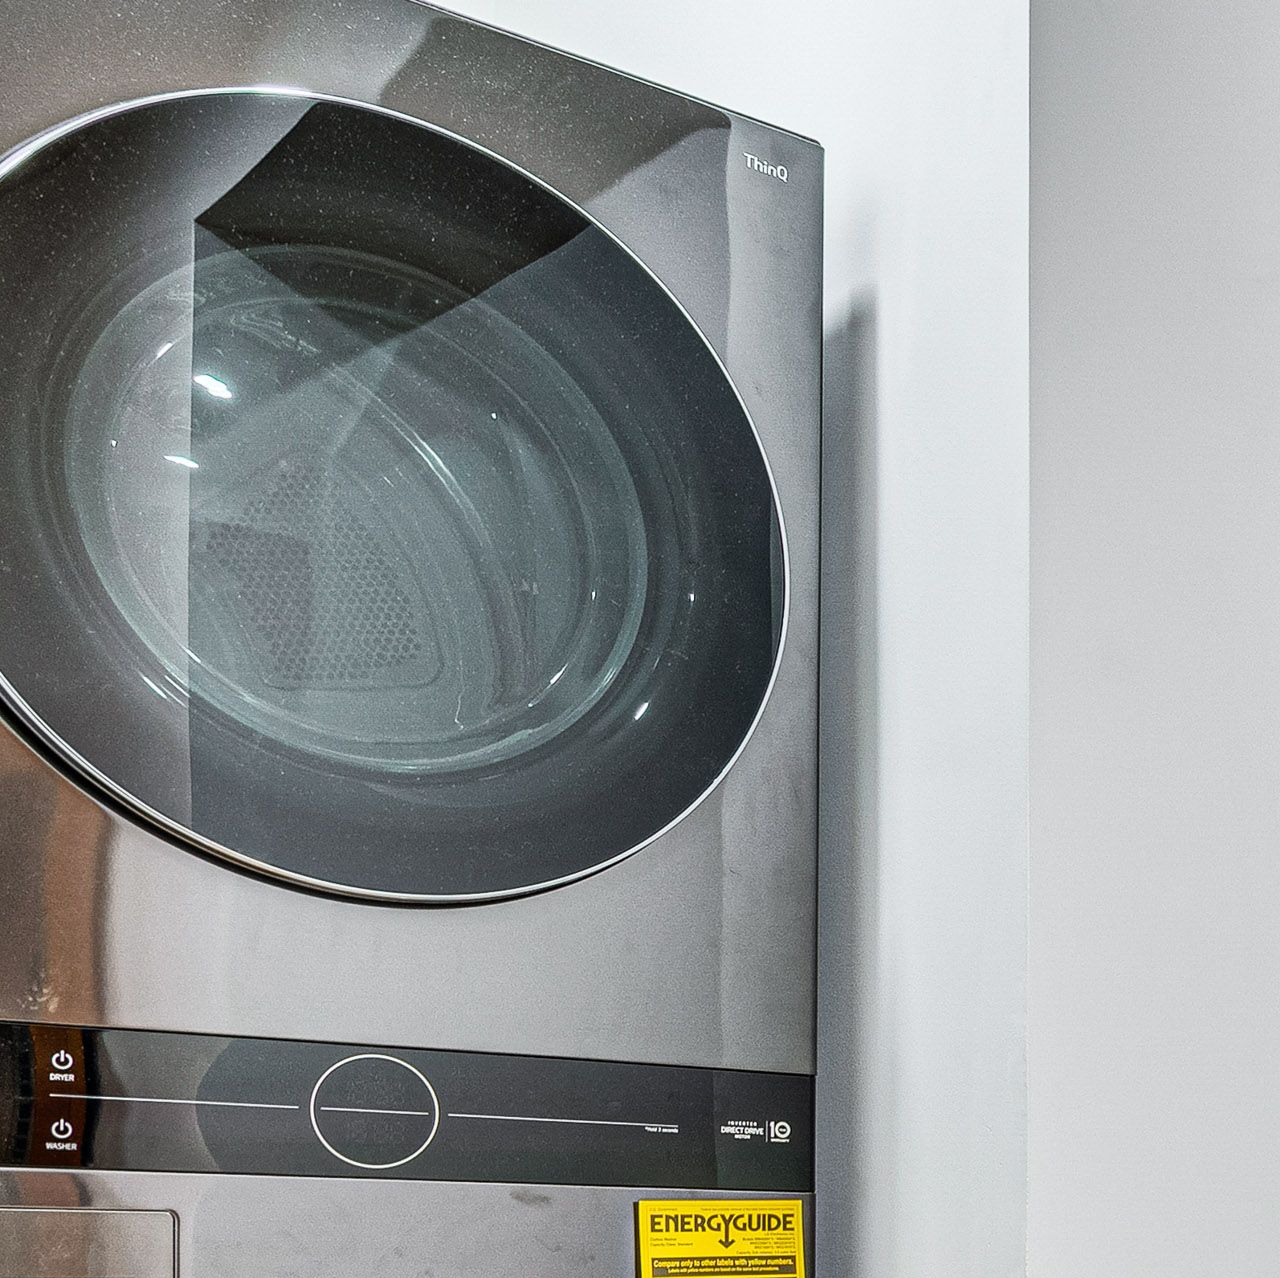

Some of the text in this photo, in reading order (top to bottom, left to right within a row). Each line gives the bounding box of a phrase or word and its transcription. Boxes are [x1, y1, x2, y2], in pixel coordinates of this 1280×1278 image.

[743, 152, 788, 183] ThinQ
[49, 1073, 75, 1082] DRYER
[720, 1125, 764, 1136] DIRECT DRIVE
[769, 1121, 791, 1139] 10
[45, 1142, 77, 1151] WASHER
[650, 1213, 795, 1233] ENERGYGUIDE
